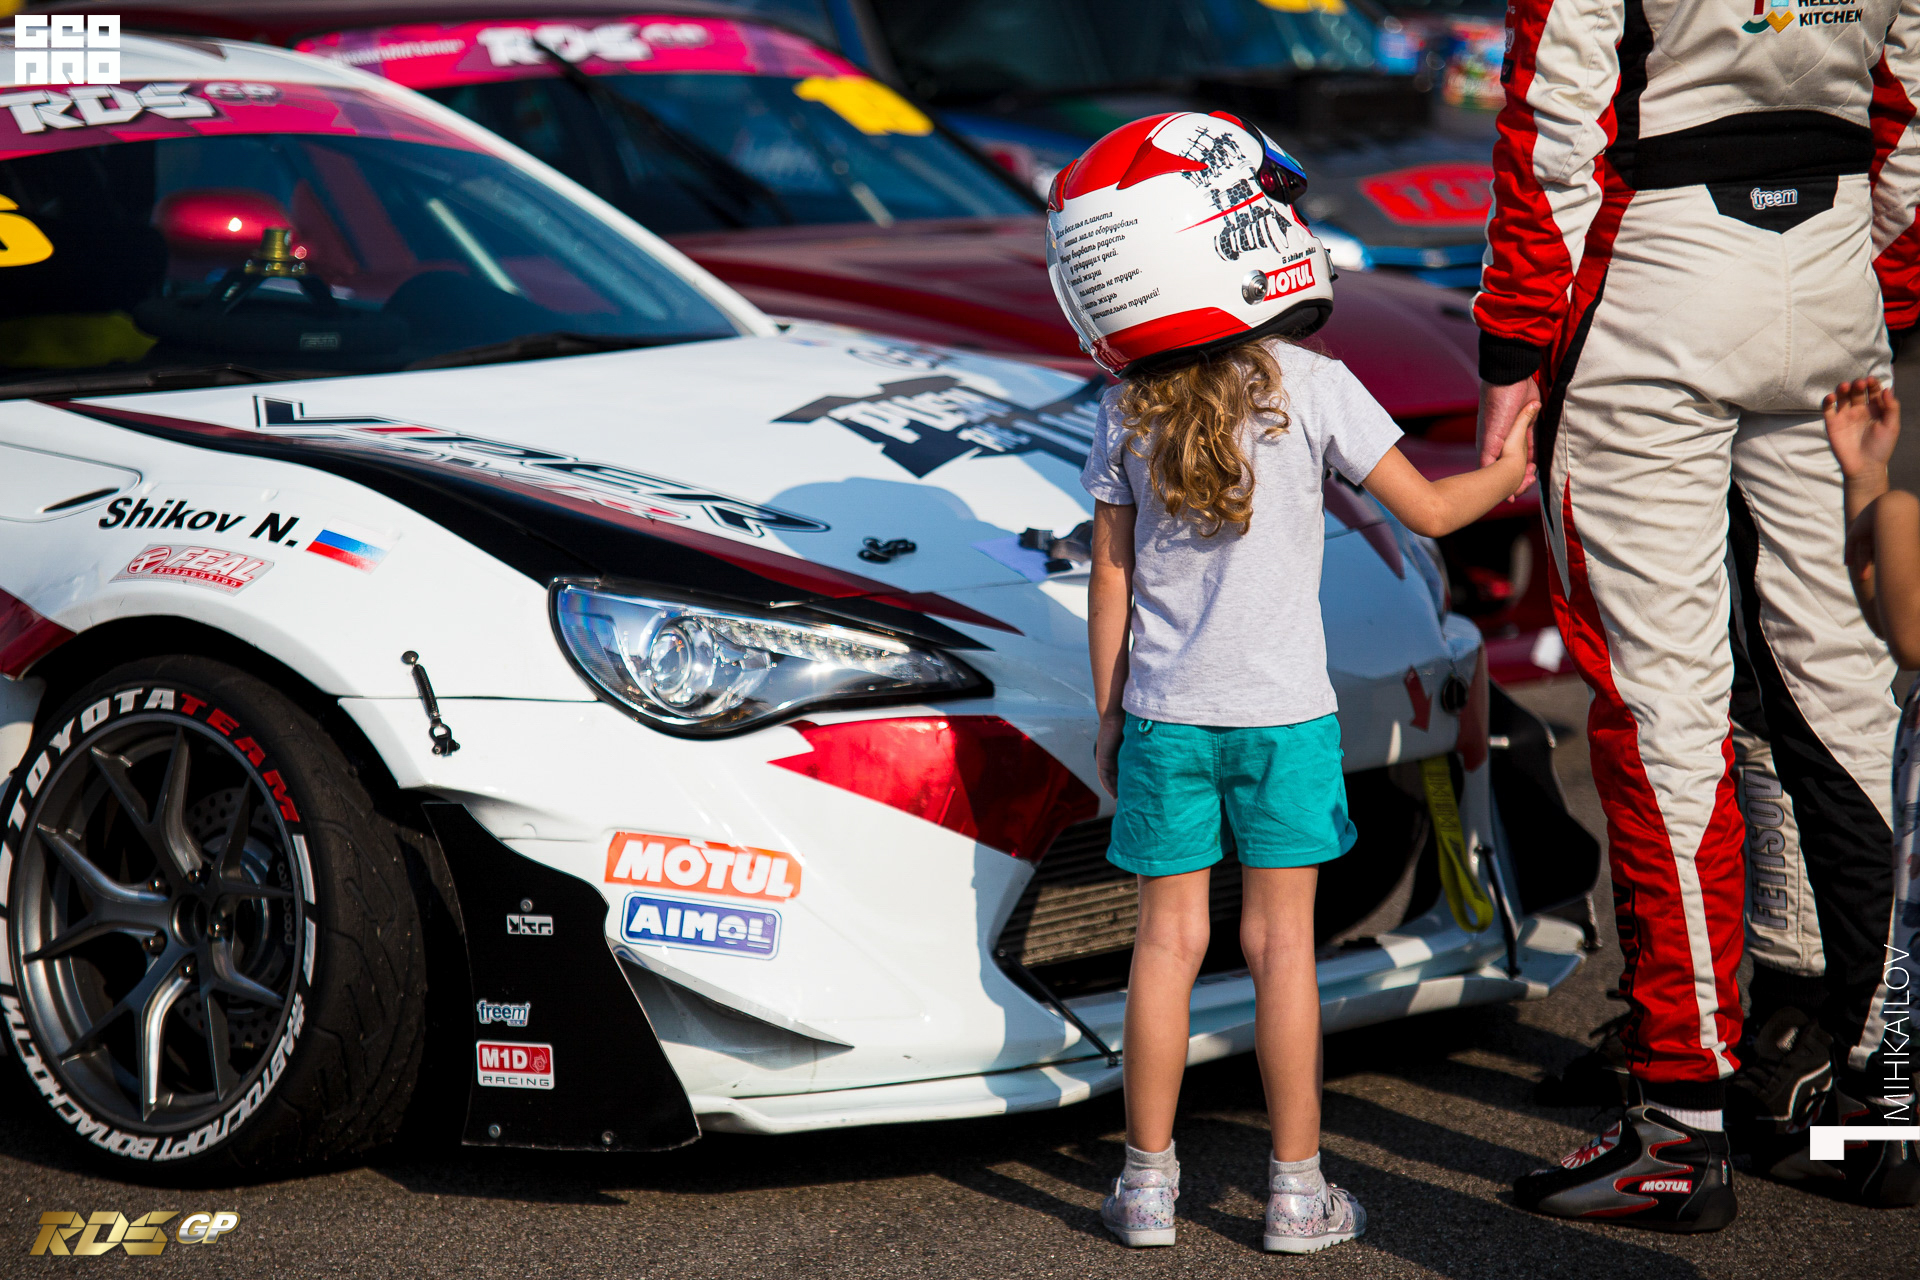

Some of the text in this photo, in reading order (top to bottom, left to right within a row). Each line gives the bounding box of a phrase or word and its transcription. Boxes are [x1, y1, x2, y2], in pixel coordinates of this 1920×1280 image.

[1799, 8, 1863, 27] KITCHEN
[0, 83, 216, 134] RDS
[1752, 189, 1797, 208] freem
[1084, 211, 1113, 225] планета
[1078, 231, 1094, 242] мало
[1095, 218, 1138, 236] оборудована
[1097, 234, 1126, 251] радость
[1101, 248, 1119, 262] дней.
[1082, 269, 1102, 282] жизни
[1105, 278, 1114, 287] не
[1113, 268, 1143, 284] трудно.
[1266, 263, 1314, 297] MOTUL
[1097, 292, 1118, 303] жизнь
[1128, 287, 1161, 307] трудней!
[98, 498, 300, 548] Shikov N.
[162, 546, 264, 582] FEAL
[7, 687, 300, 832] TOYOTA TEAM
[1743, 768, 1788, 930] FETISOV
[613, 839, 795, 898] MOTUL
[478, 1000, 529, 1021] freem
[481, 1047, 528, 1070] M1D
[482, 1076, 550, 1087] RACING
[1641, 1181, 1690, 1192] MOTUL
